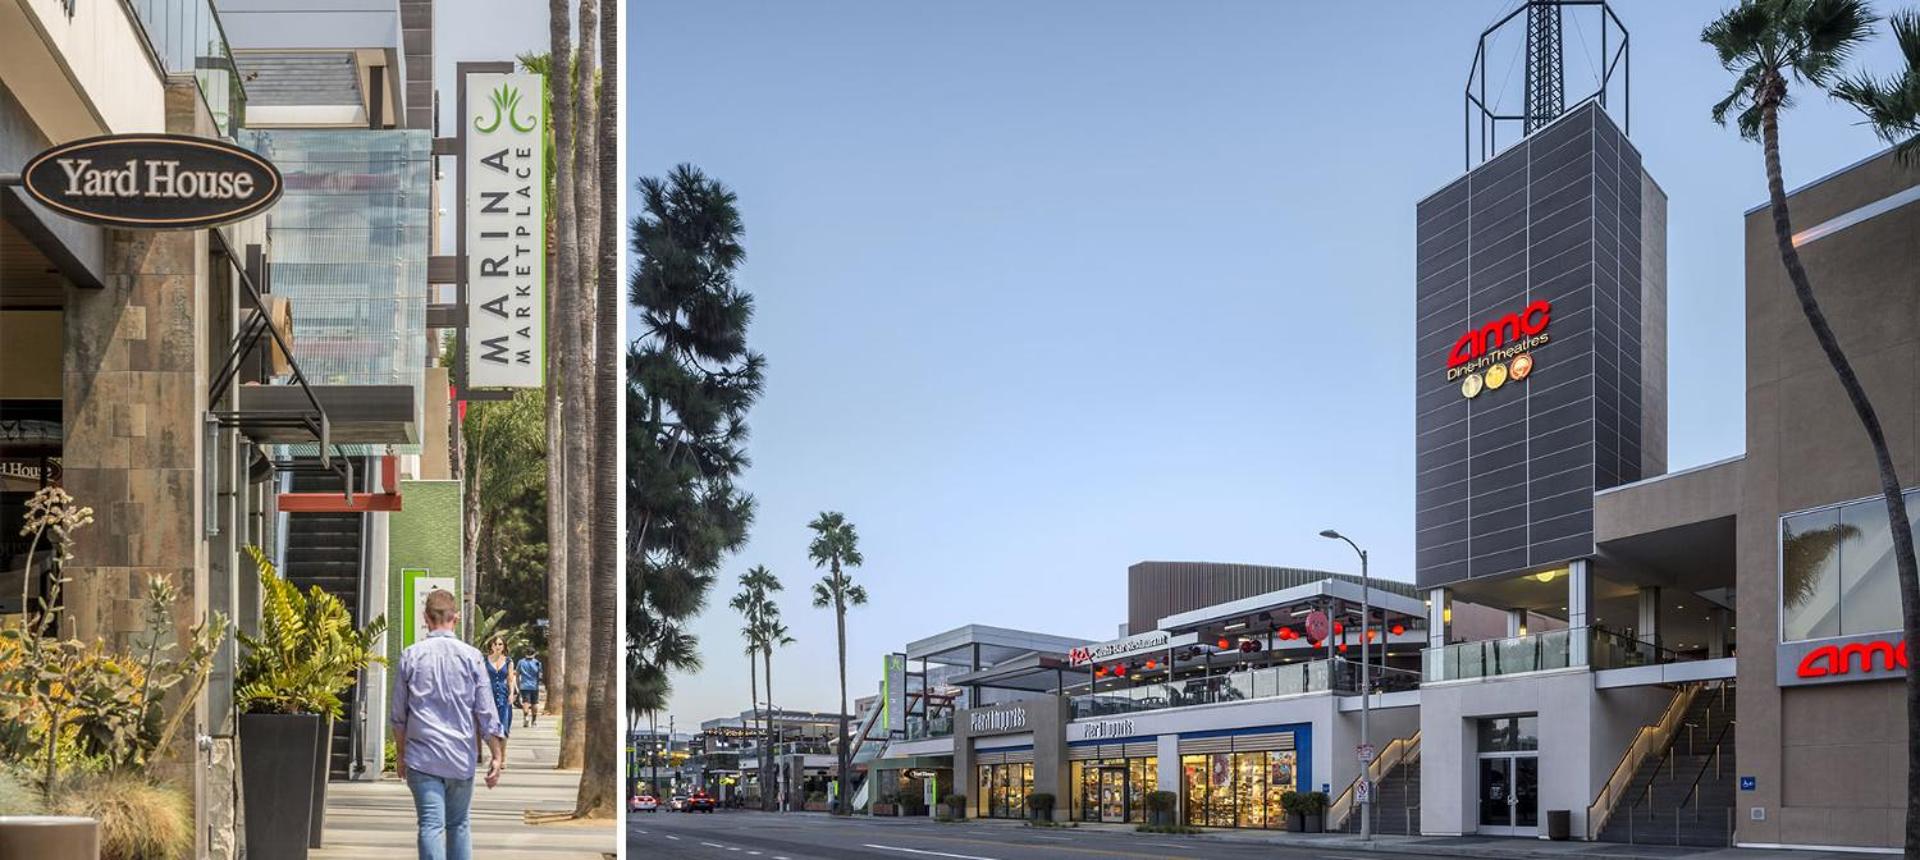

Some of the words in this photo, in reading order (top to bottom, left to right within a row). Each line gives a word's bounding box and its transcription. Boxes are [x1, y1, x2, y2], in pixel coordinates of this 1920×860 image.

[56, 158, 139, 197] Yard
[144, 159, 254, 199] House
[480, 148, 509, 364] MARINA
[515, 147, 532, 364] MARKETPLACE
[1447, 300, 1552, 368] amc
